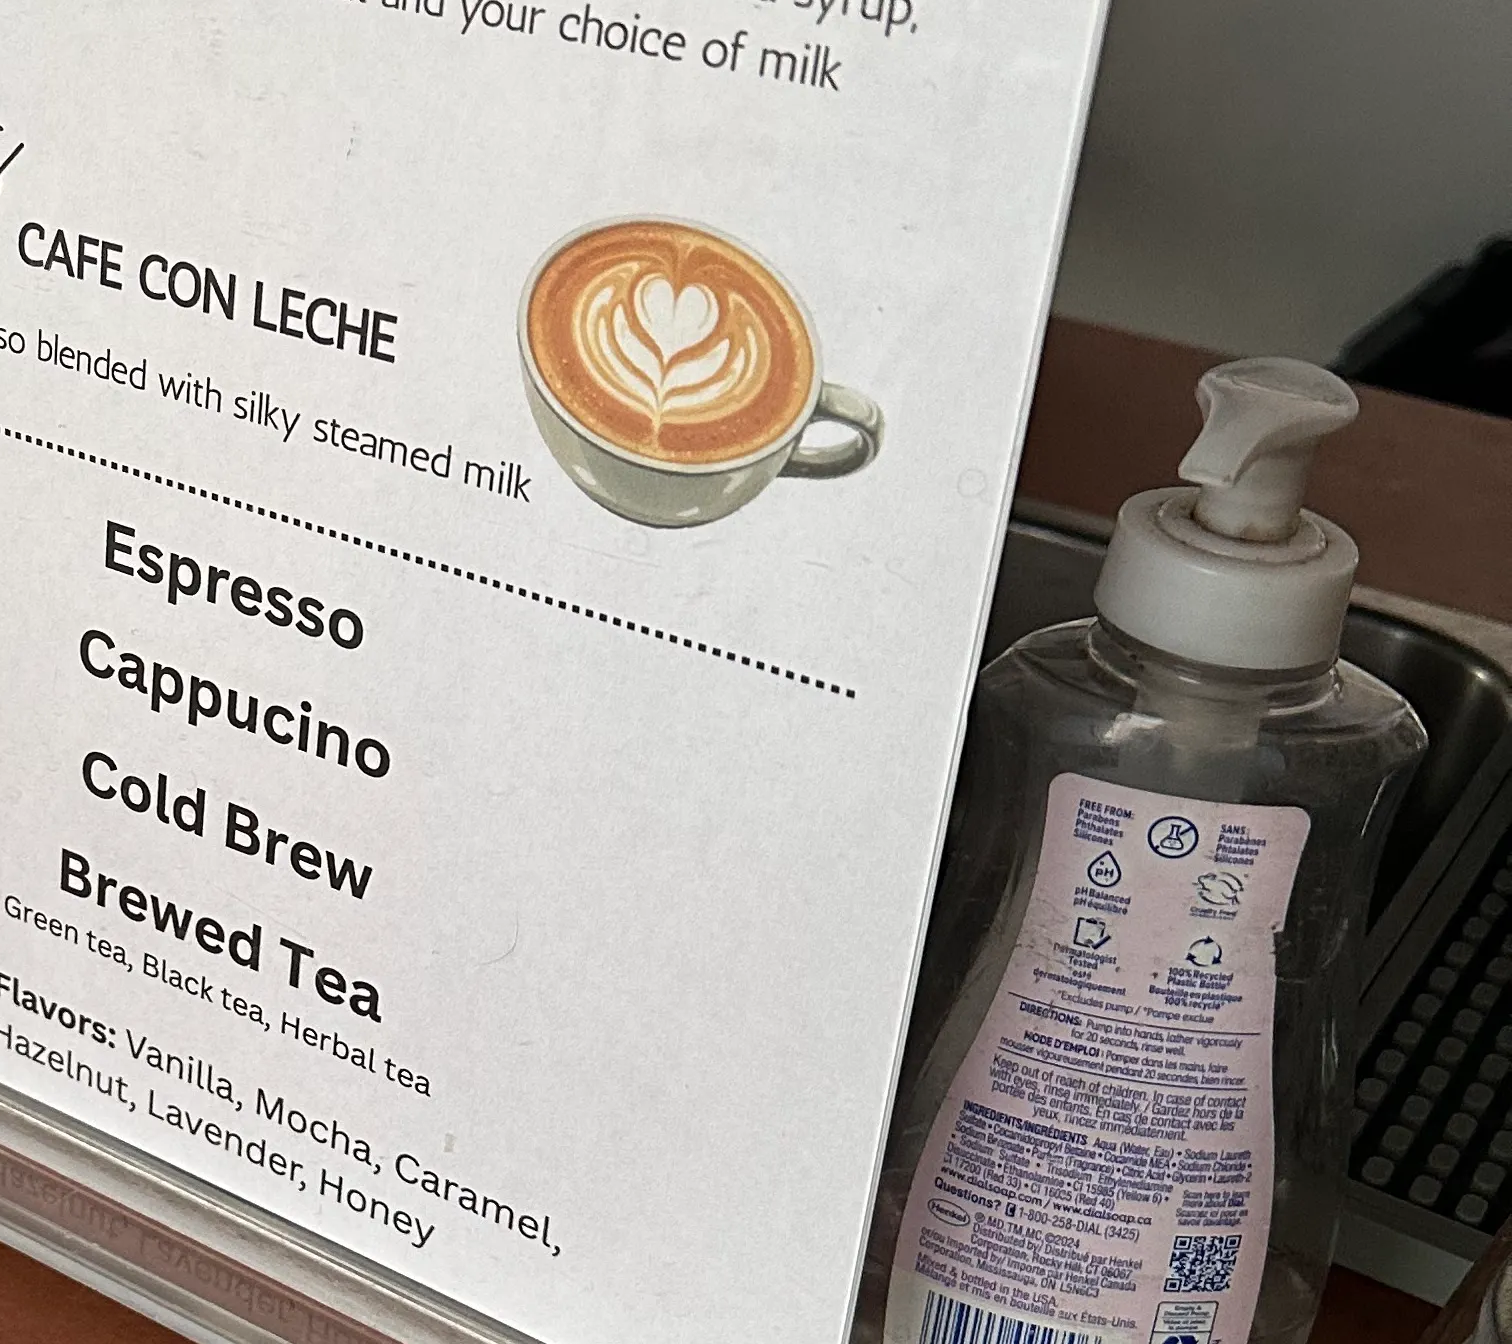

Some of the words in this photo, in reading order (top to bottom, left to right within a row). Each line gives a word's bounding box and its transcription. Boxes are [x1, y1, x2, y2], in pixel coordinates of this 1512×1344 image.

[559, 3, 686, 62] choice
[701, 30, 749, 72] of
[758, 44, 842, 92] milk
[17, 221, 123, 291] CAFE
[138, 254, 237, 321] CON
[253, 280, 398, 364] LECHE
[37, 329, 147, 391] blended
[158, 372, 222, 413] with
[233, 390, 301, 443] silky
[313, 418, 452, 479] steamed
[463, 461, 532, 503] milk
[104, 519, 364, 650] Espresso
[79, 629, 391, 779] Cappucino
[81, 751, 206, 838] Cold
[225, 801, 373, 900] Brew
[1079, 798, 1104, 813] FREE
[60, 847, 262, 972] Brewed
[279, 936, 382, 1024] Tea
[4, 895, 78, 945] Green
[85, 930, 133, 973] tea,
[142, 952, 213, 1003] Black
[220, 987, 270, 1032] tea,
[280, 1011, 376, 1074] Herbal
[384, 1058, 431, 1098] tea
[1085, 1019, 1112, 1034] Pump
[1085, 1030, 1098, 1042] 20
[991, 1052, 1020, 1073] Keep
[1020, 1063, 1040, 1078] out
[1040, 1068, 1054, 1083] of
[1055, 1072, 1087, 1090] reach
[1165, 1093, 1191, 1105] case
[1193, 1093, 1206, 1106] of
[125, 1028, 243, 1112] Vanilla,
[256, 1087, 381, 1175] Mocha,
[395, 1153, 561, 1257] Caramel,
[148, 1089, 306, 1192] Lavender,
[320, 1168, 435, 1249] Honey
[930, 1201, 967, 1222] Henkel
[933, 1175, 1001, 1211] Questions?
[1017, 1204, 1103, 1236] 1-800-258-DIAL
[1103, 1223, 1140, 1244] (3425)
[1052, 1199, 1152, 1227] www.dialsoap.ca
[1108, 1254, 1143, 1270] Henkel
